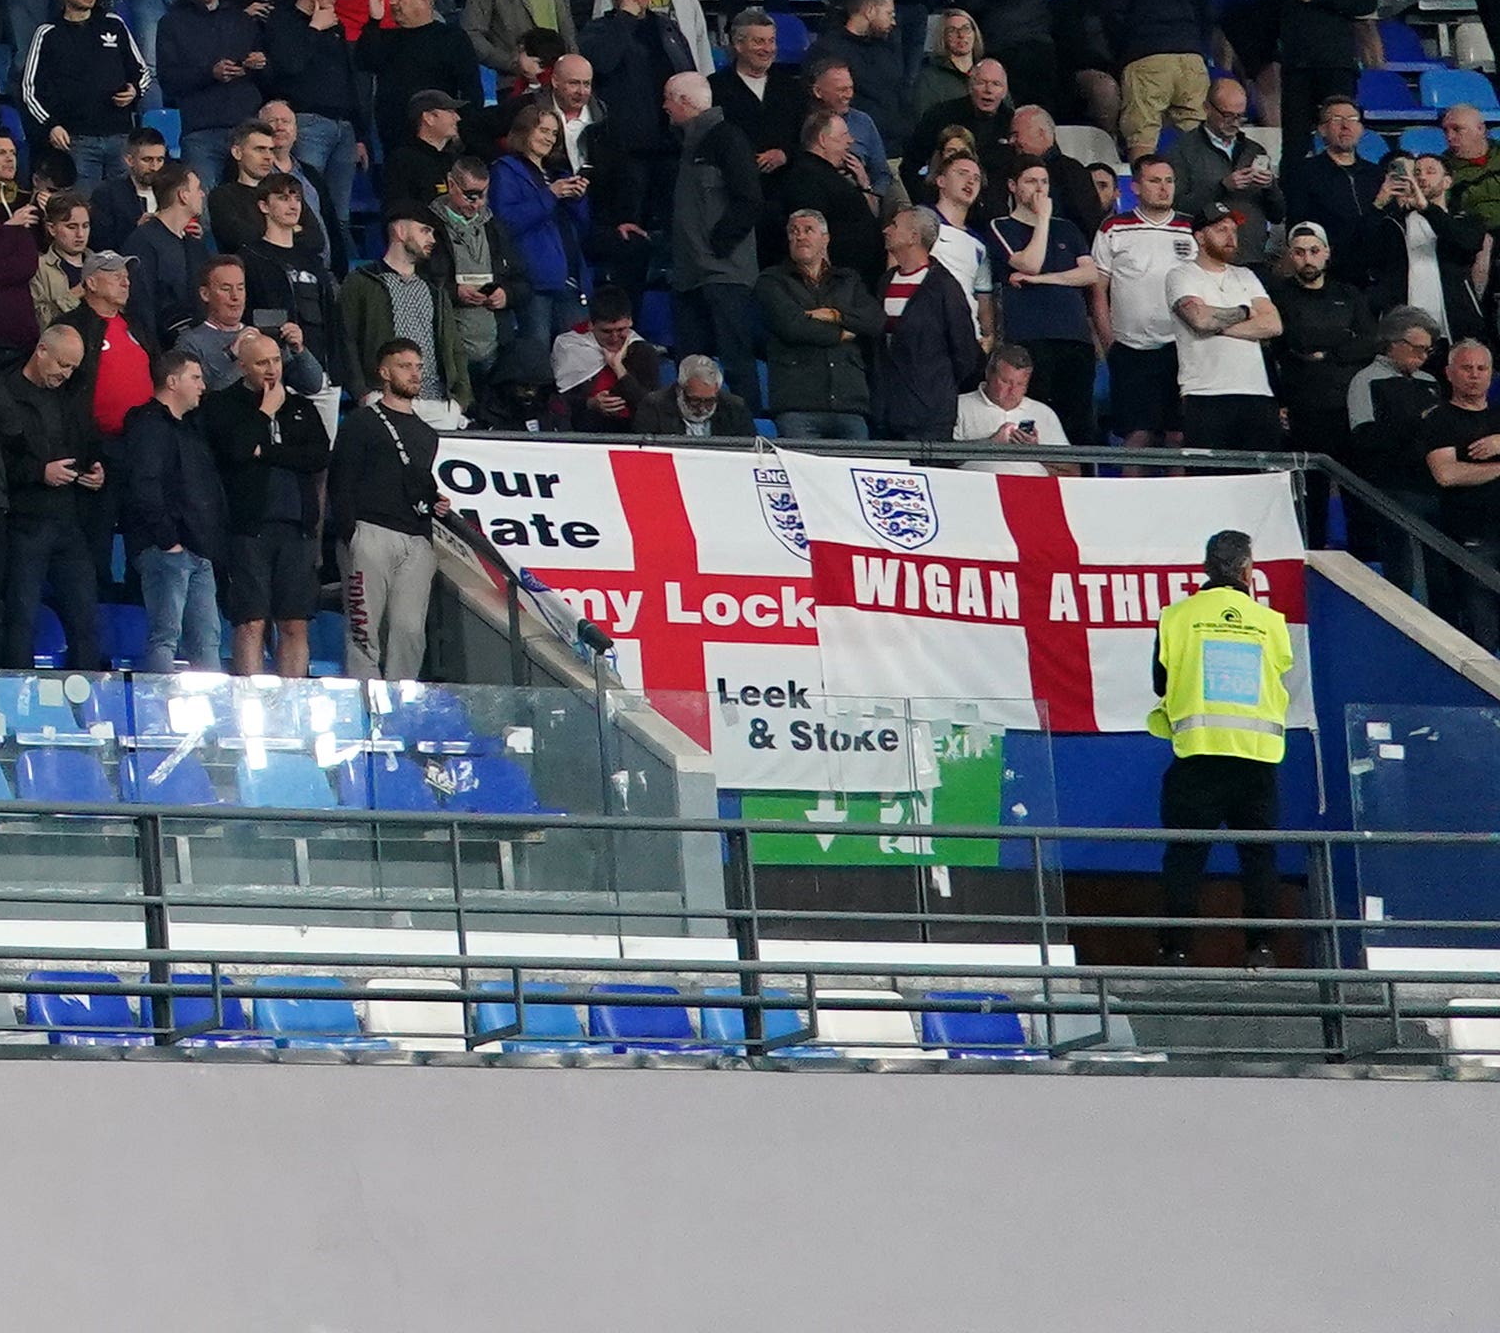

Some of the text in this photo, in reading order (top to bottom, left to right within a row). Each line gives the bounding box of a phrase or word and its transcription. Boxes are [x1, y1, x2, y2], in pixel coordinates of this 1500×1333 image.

[437, 459, 560, 500] Our
[757, 469, 788, 483] ENG
[851, 554, 1020, 620] WIGAN
[554, 587, 643, 633] my
[716, 677, 812, 710] Leek
[748, 717, 900, 752] & Stoke
